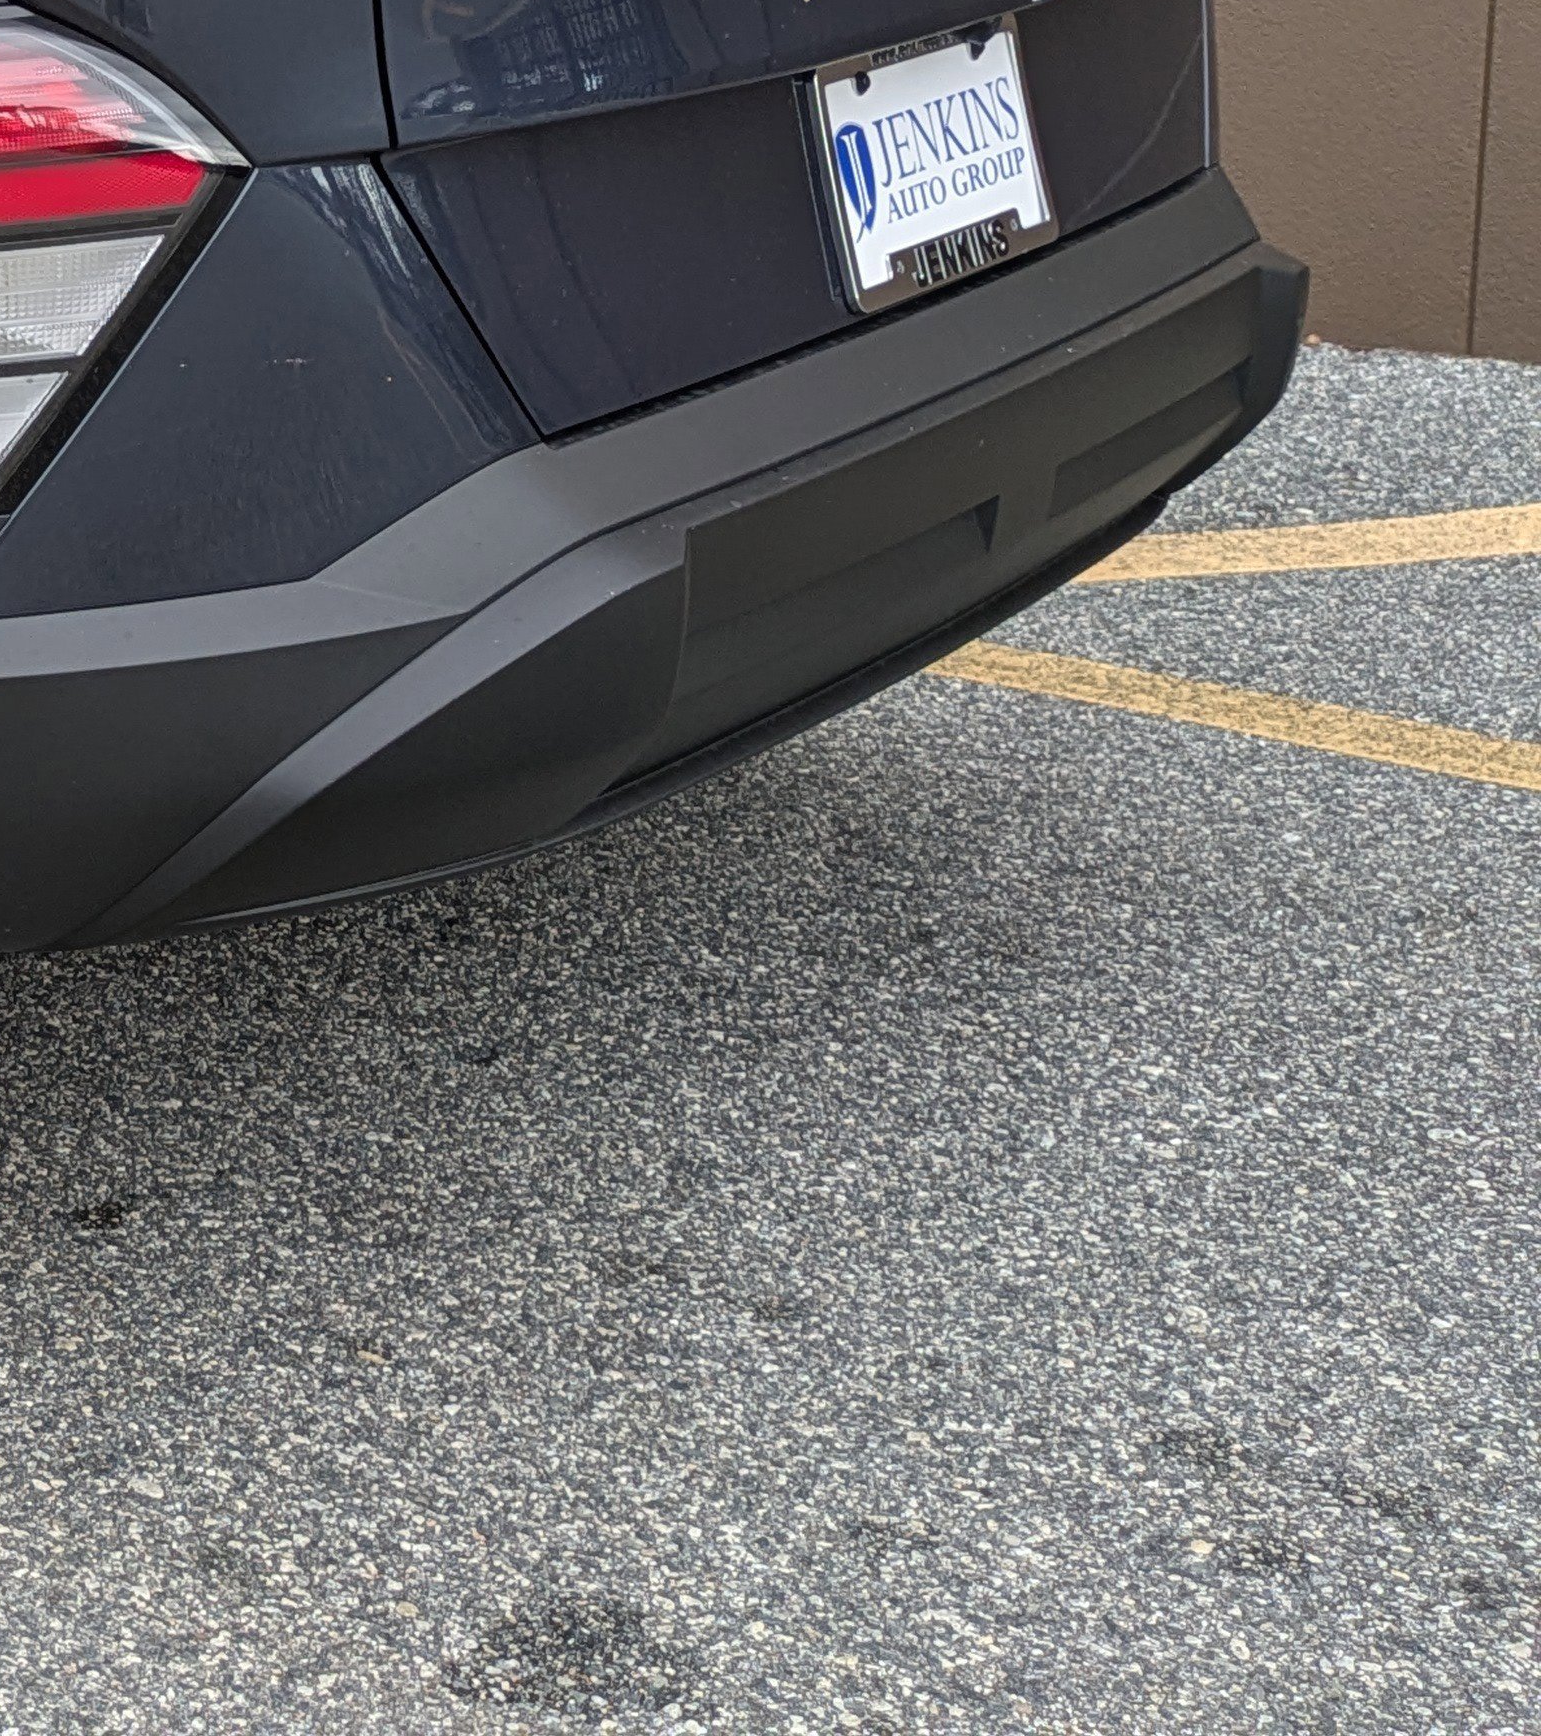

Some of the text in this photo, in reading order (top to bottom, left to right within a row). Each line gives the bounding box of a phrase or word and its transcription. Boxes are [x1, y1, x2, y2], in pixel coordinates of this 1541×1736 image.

[872, 76, 1019, 188] JENKINS
[887, 146, 1025, 224] AUTO GROUP
[911, 219, 1010, 288] JENKINS
